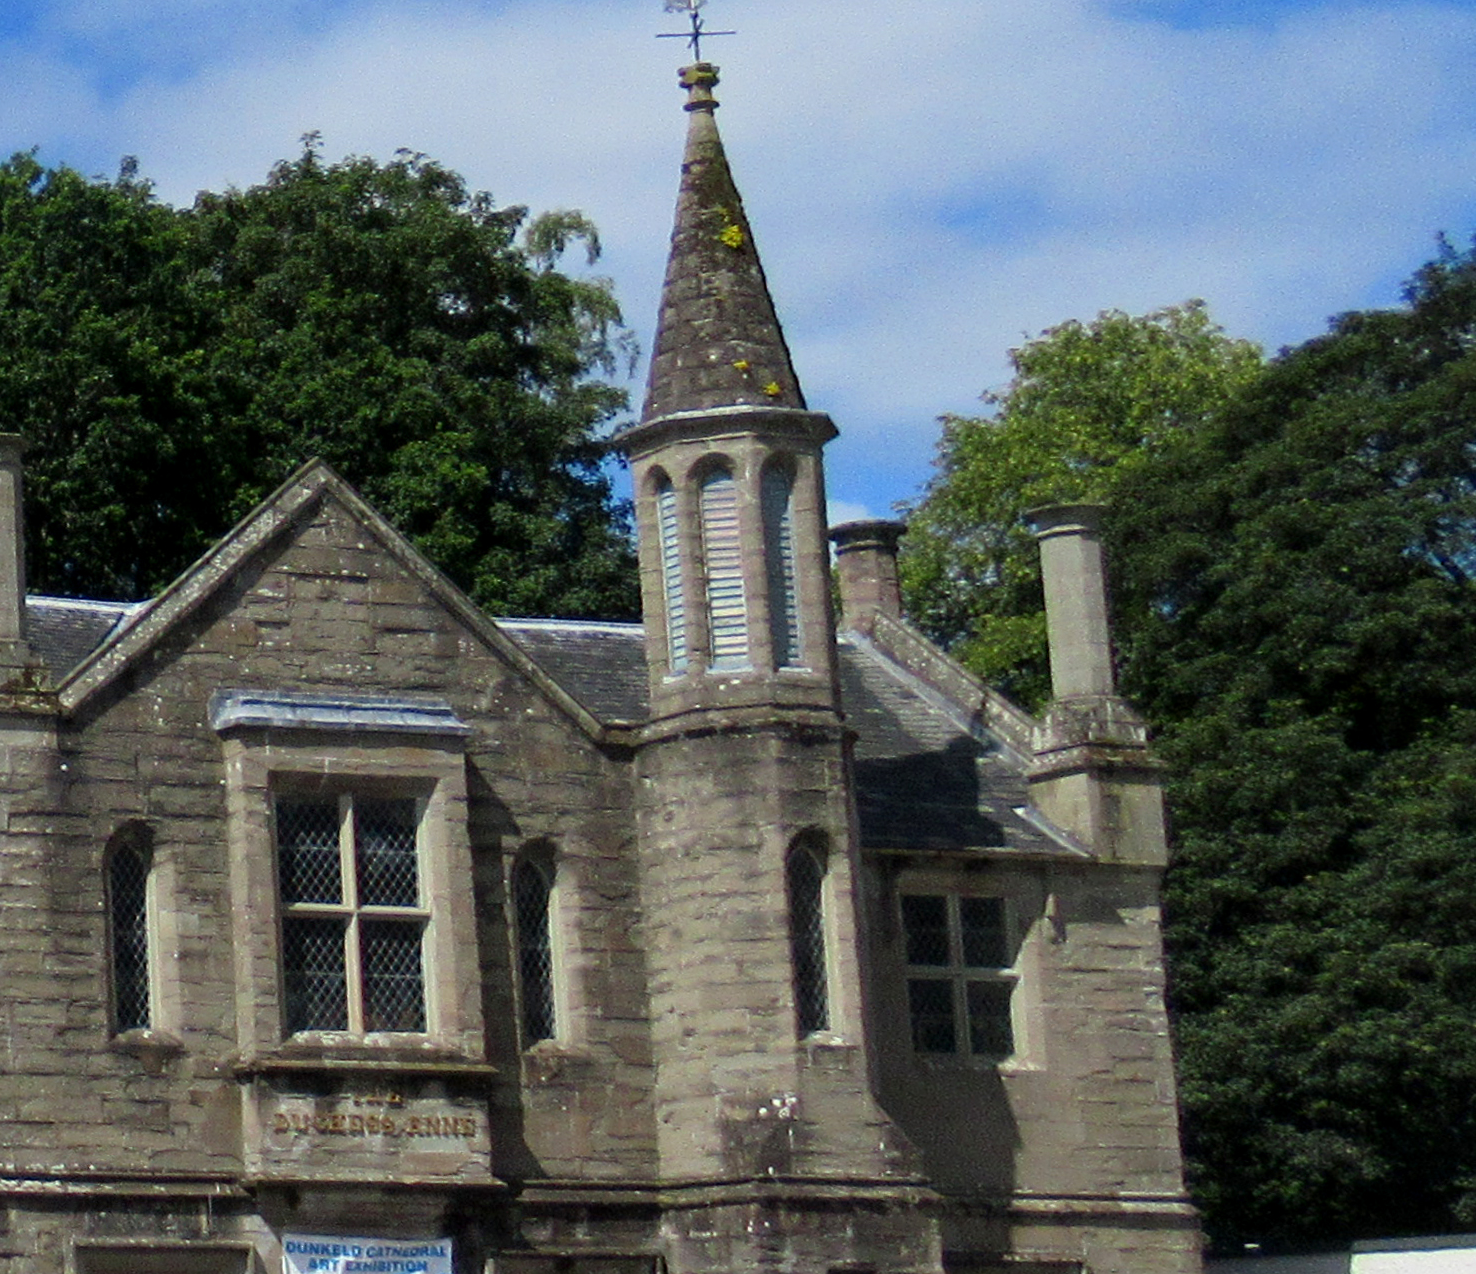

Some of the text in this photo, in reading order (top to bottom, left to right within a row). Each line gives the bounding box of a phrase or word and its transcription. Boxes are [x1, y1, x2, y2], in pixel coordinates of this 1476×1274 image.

[285, 1241, 447, 1258] DUNKELD CATHEDRAL
[307, 1257, 429, 1273] ART EXHIBITION
